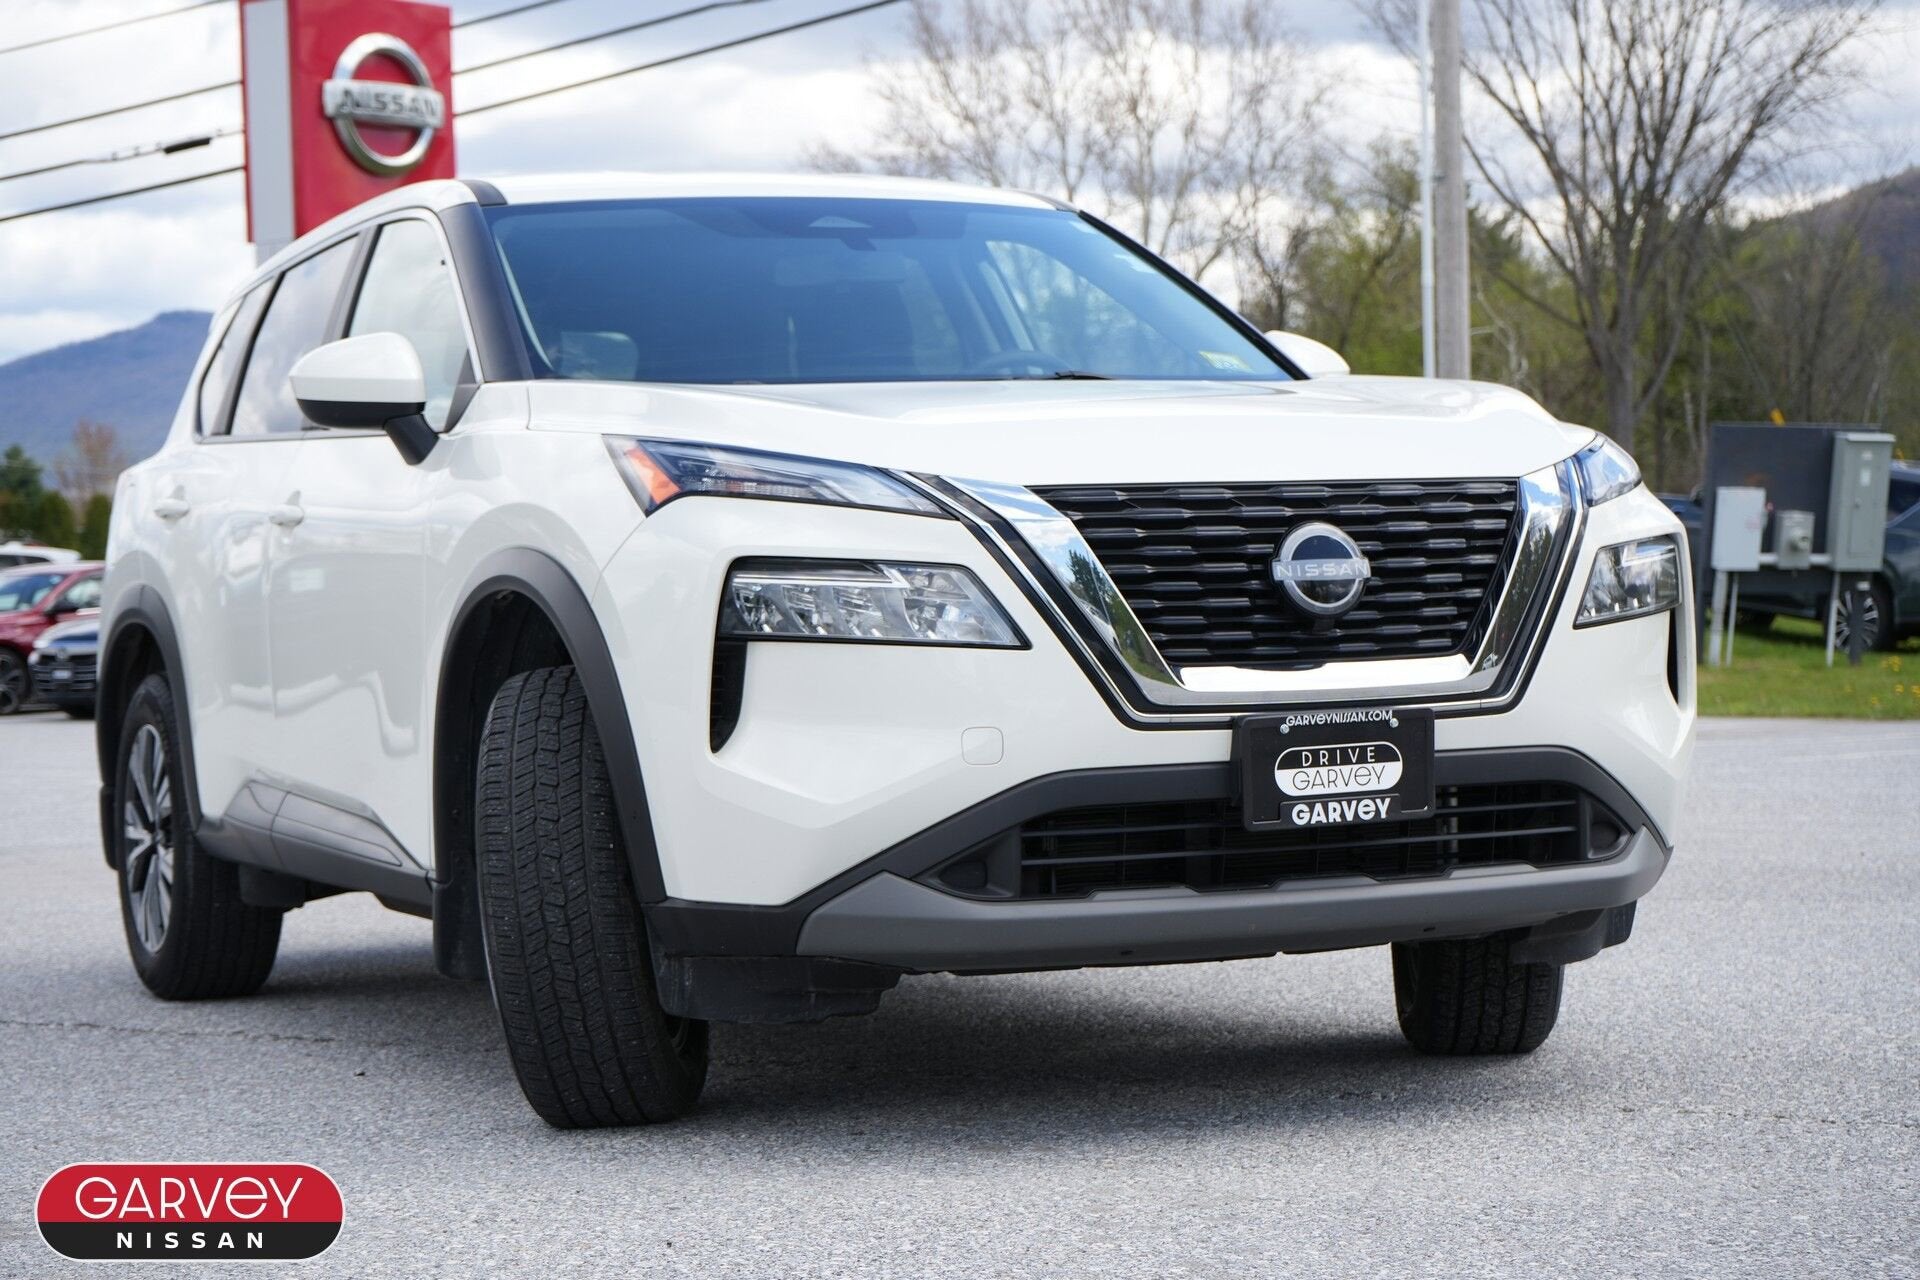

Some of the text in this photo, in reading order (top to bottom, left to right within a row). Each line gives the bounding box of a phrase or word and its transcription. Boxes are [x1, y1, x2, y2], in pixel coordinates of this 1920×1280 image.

[335, 89, 437, 117] NISSAN
[1277, 563, 1368, 577] NISSAN
[1302, 746, 1375, 767] DRIVE
